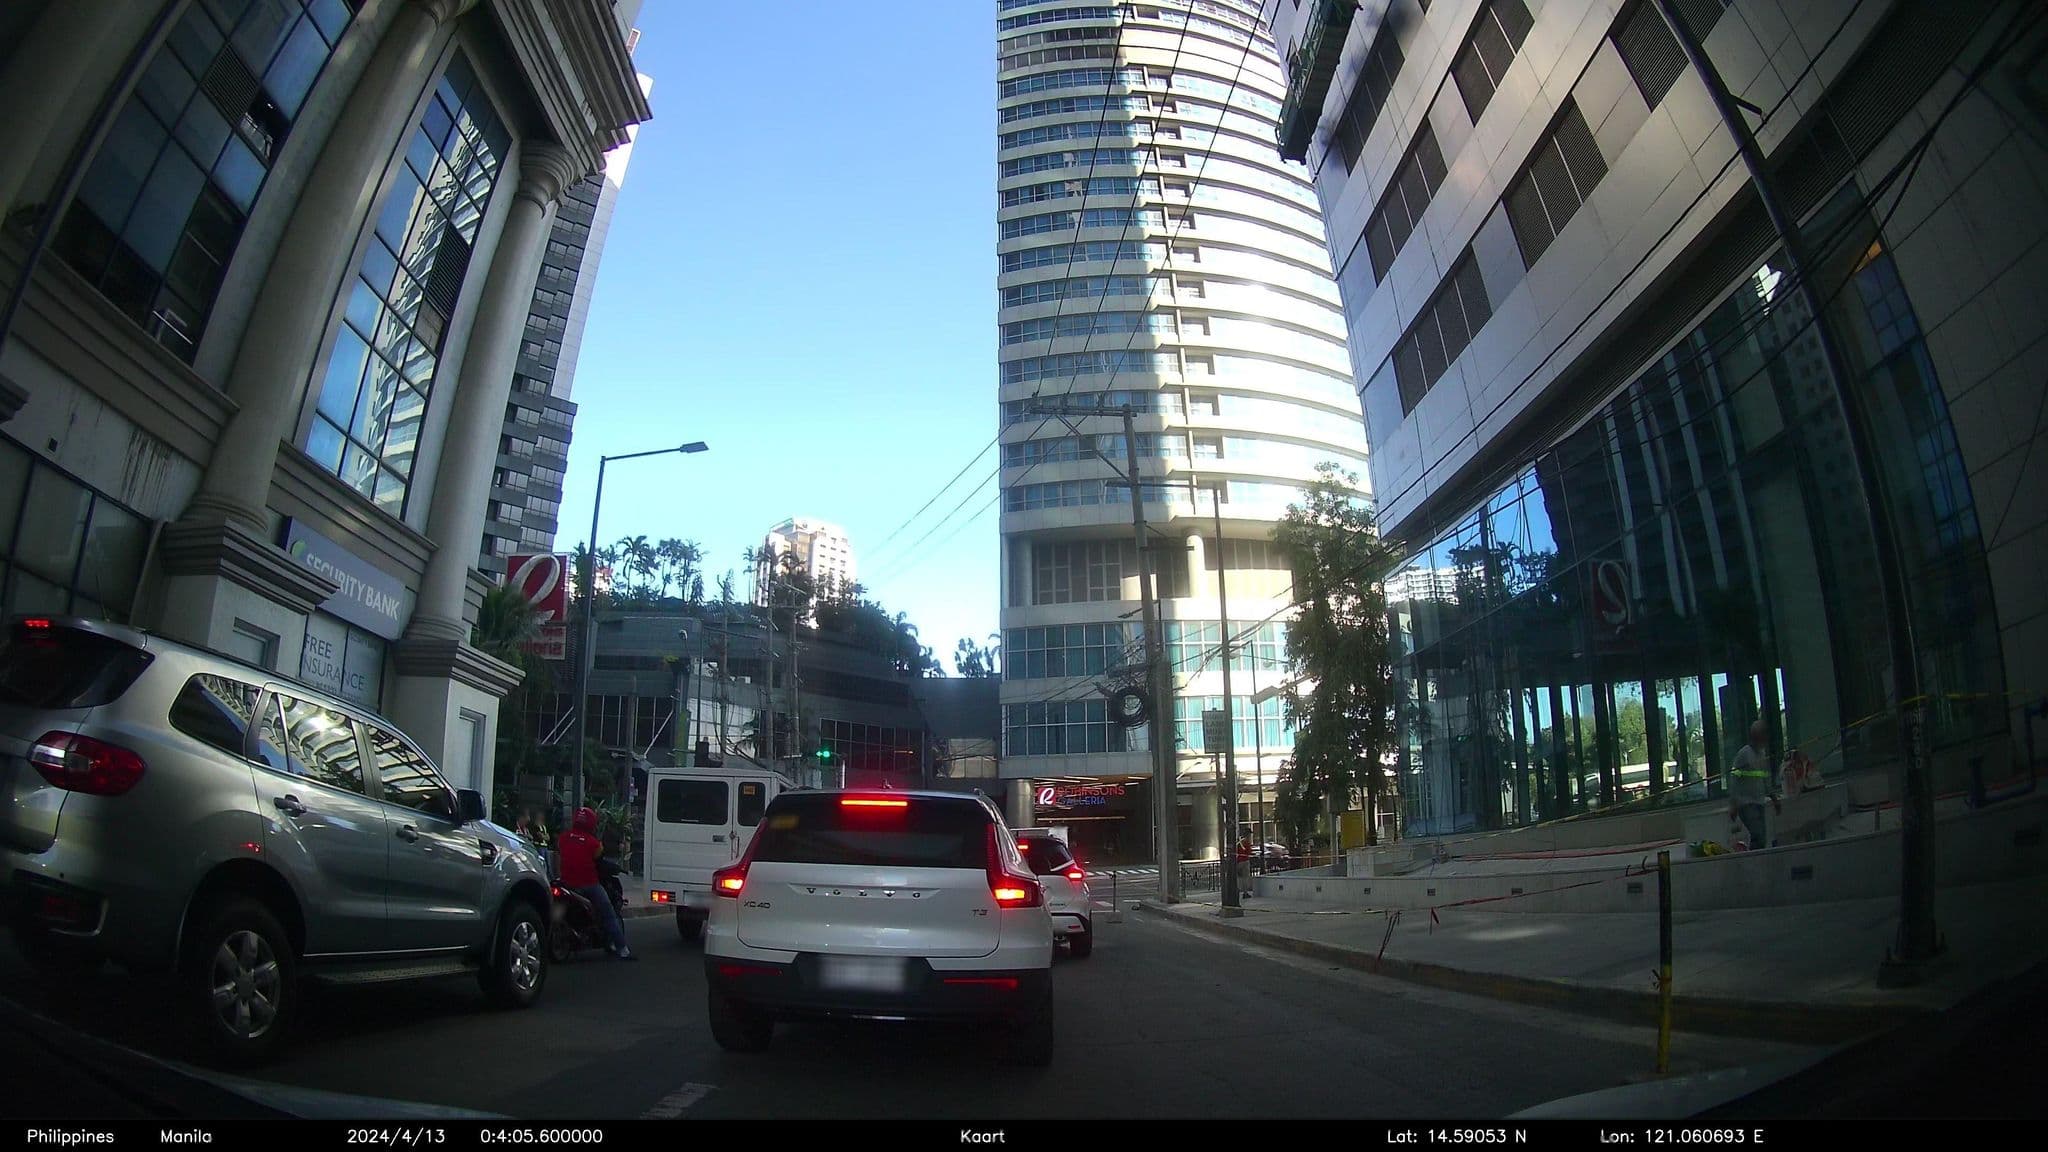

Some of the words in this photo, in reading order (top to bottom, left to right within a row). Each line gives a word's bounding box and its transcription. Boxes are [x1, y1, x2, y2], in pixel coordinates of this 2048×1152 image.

[365, 585, 400, 620] BANK
[303, 654, 365, 691] NSURANCE
[806, 886, 922, 899] VOLVO
